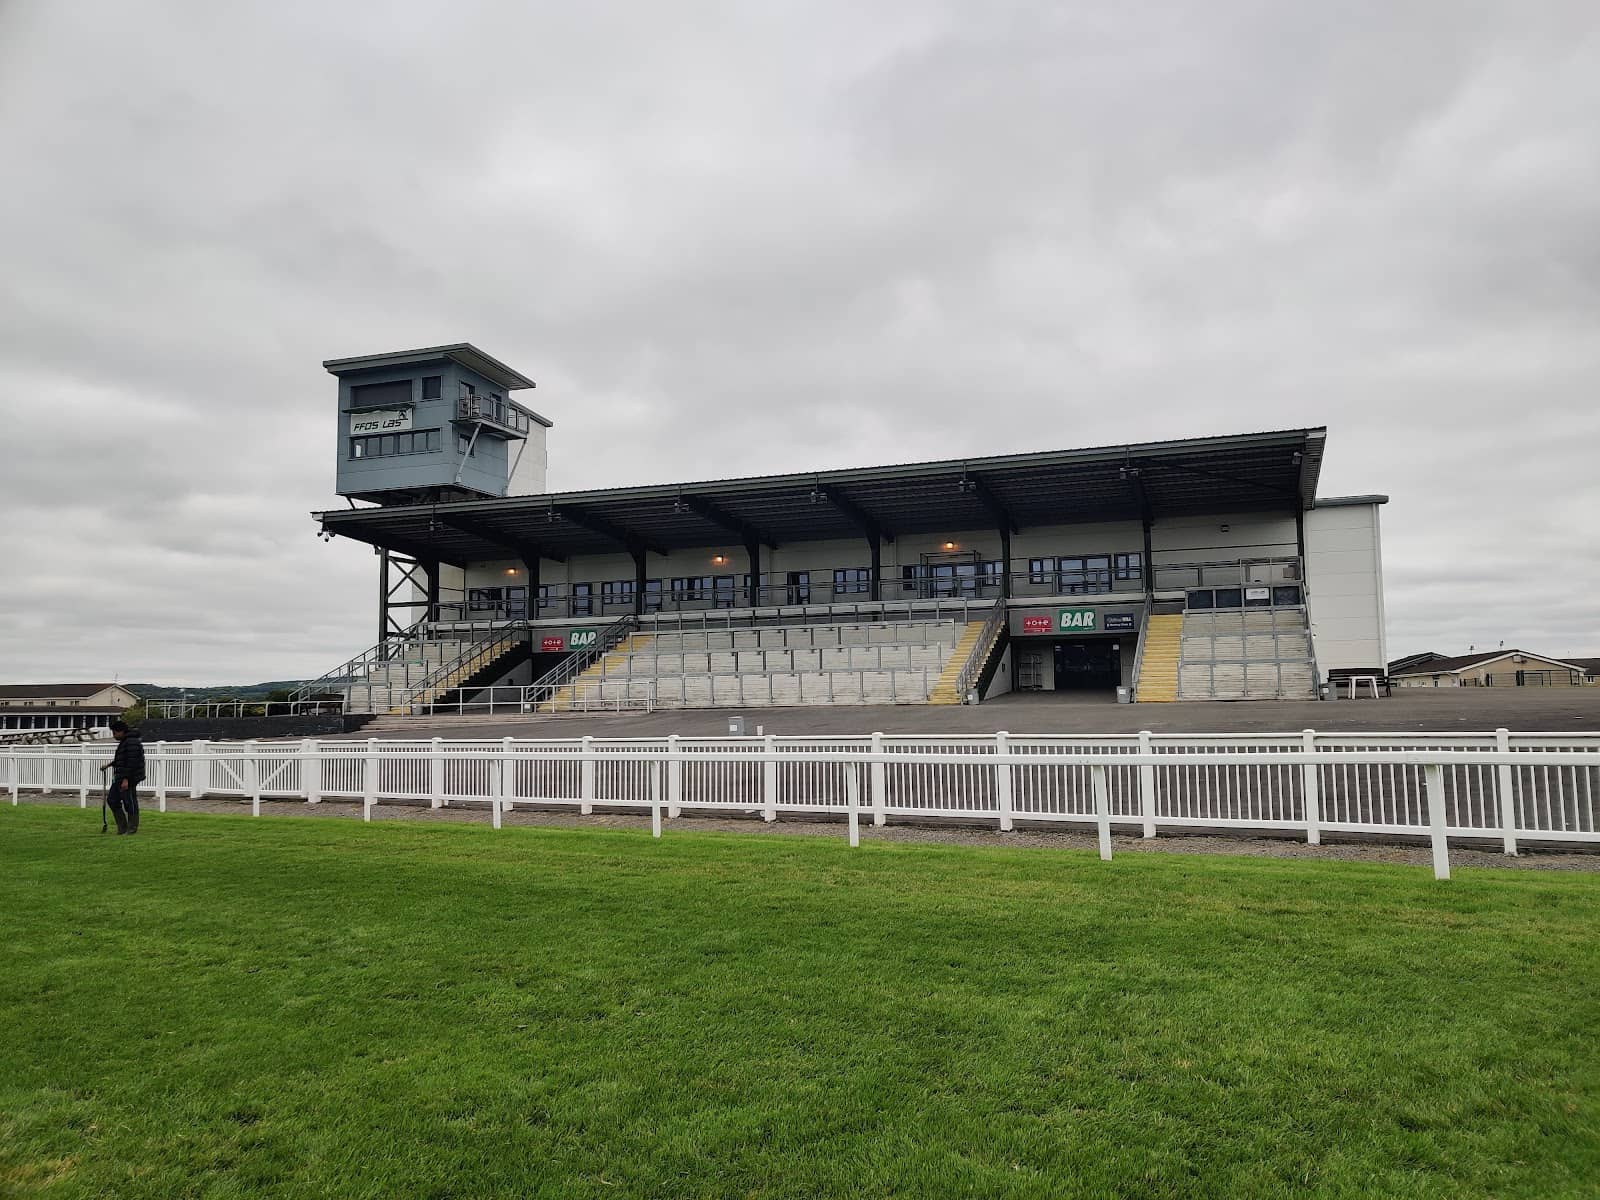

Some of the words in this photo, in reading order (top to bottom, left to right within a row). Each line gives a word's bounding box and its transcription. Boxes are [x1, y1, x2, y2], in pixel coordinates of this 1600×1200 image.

[354, 421, 379, 431] FFOS
[1061, 612, 1094, 627] BAR
[571, 631, 596, 646] BAR
